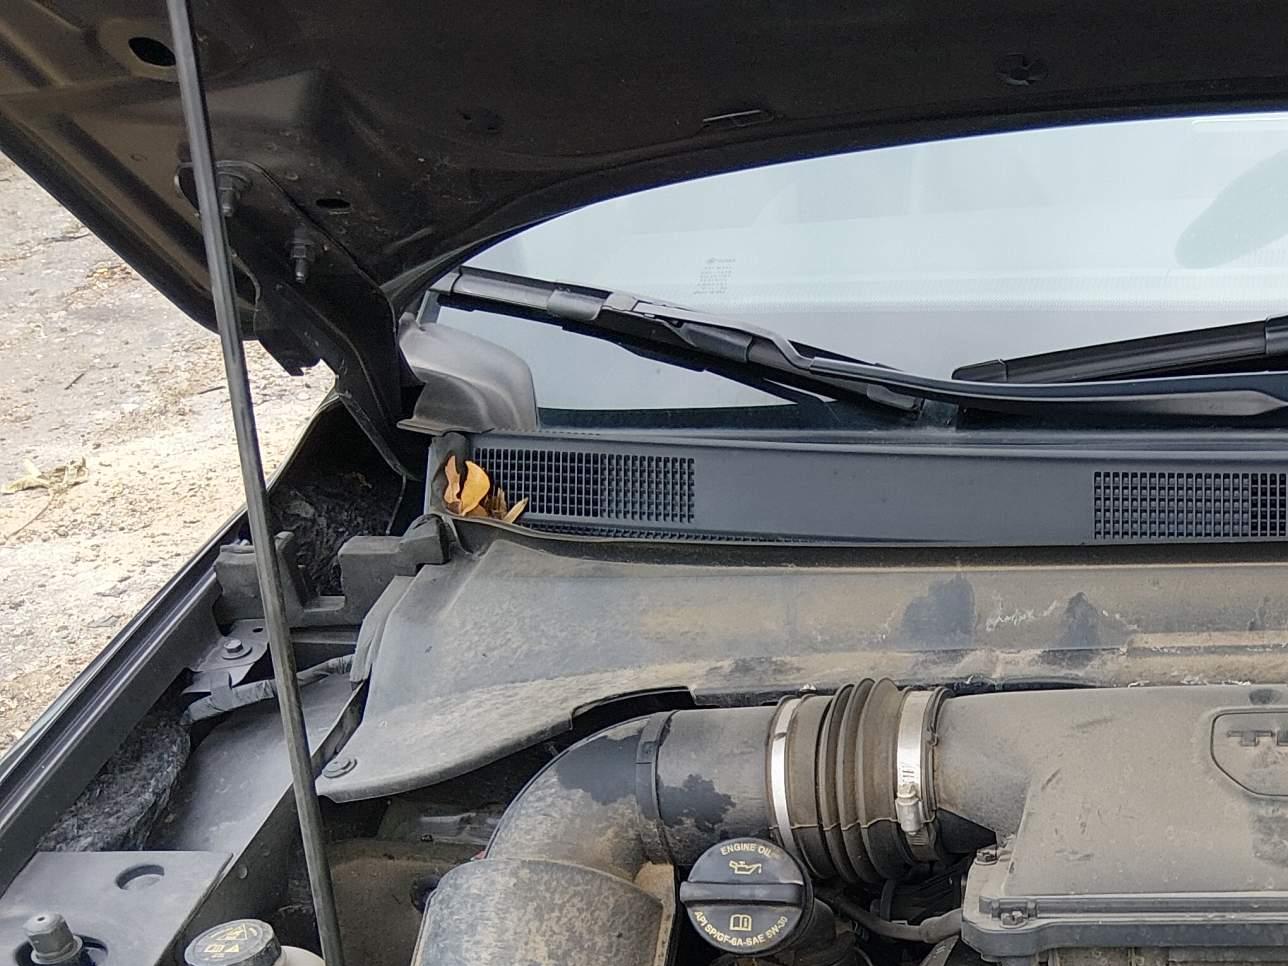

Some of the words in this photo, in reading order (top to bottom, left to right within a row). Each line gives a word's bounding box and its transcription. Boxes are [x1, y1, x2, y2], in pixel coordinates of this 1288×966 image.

[720, 843, 756, 856] ENGINE
[759, 845, 772, 857] OIL
[694, 911, 708, 927] API
[767, 916, 788, 939] 5W-30
